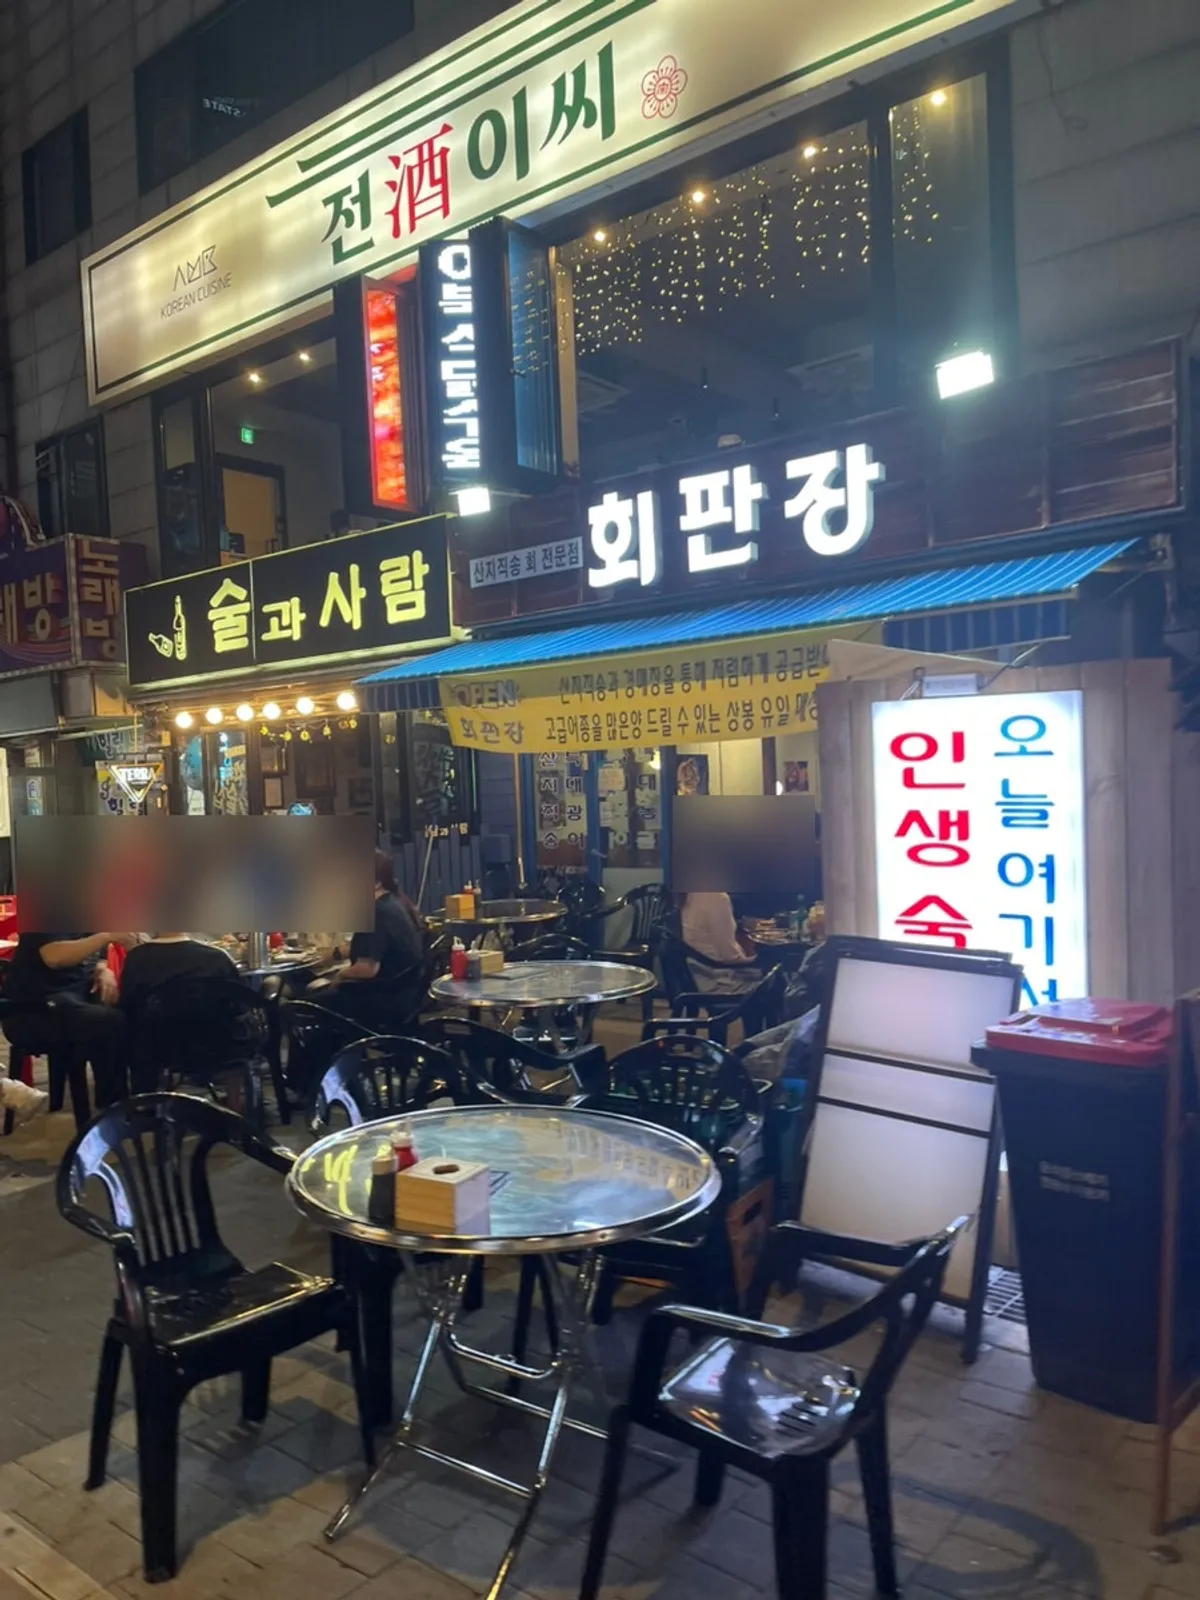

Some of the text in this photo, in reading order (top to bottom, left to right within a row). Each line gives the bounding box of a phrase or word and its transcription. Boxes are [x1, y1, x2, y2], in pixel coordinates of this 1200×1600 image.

[160, 271, 232, 319] KOREAN CUISINE
[588, 443, 886, 588] 회판장
[473, 540, 579, 584] 산지직송 회 전문점
[208, 550, 430, 653] 술과 사람
[559, 669, 619, 705] 산지직송과
[623, 664, 674, 699] 경매장을
[680, 661, 706, 692] 통해
[712, 652, 769, 689] 저렴하게
[459, 715, 525, 745] 회판장
[545, 713, 603, 744] 고급어종을
[647, 707, 672, 737] 드릴
[677, 705, 689, 735] 수
[694, 703, 721, 734] 있는
[726, 699, 755, 731] 상봉
[761, 694, 790, 728] 유일
[994, 714, 1055, 829] 오늘
